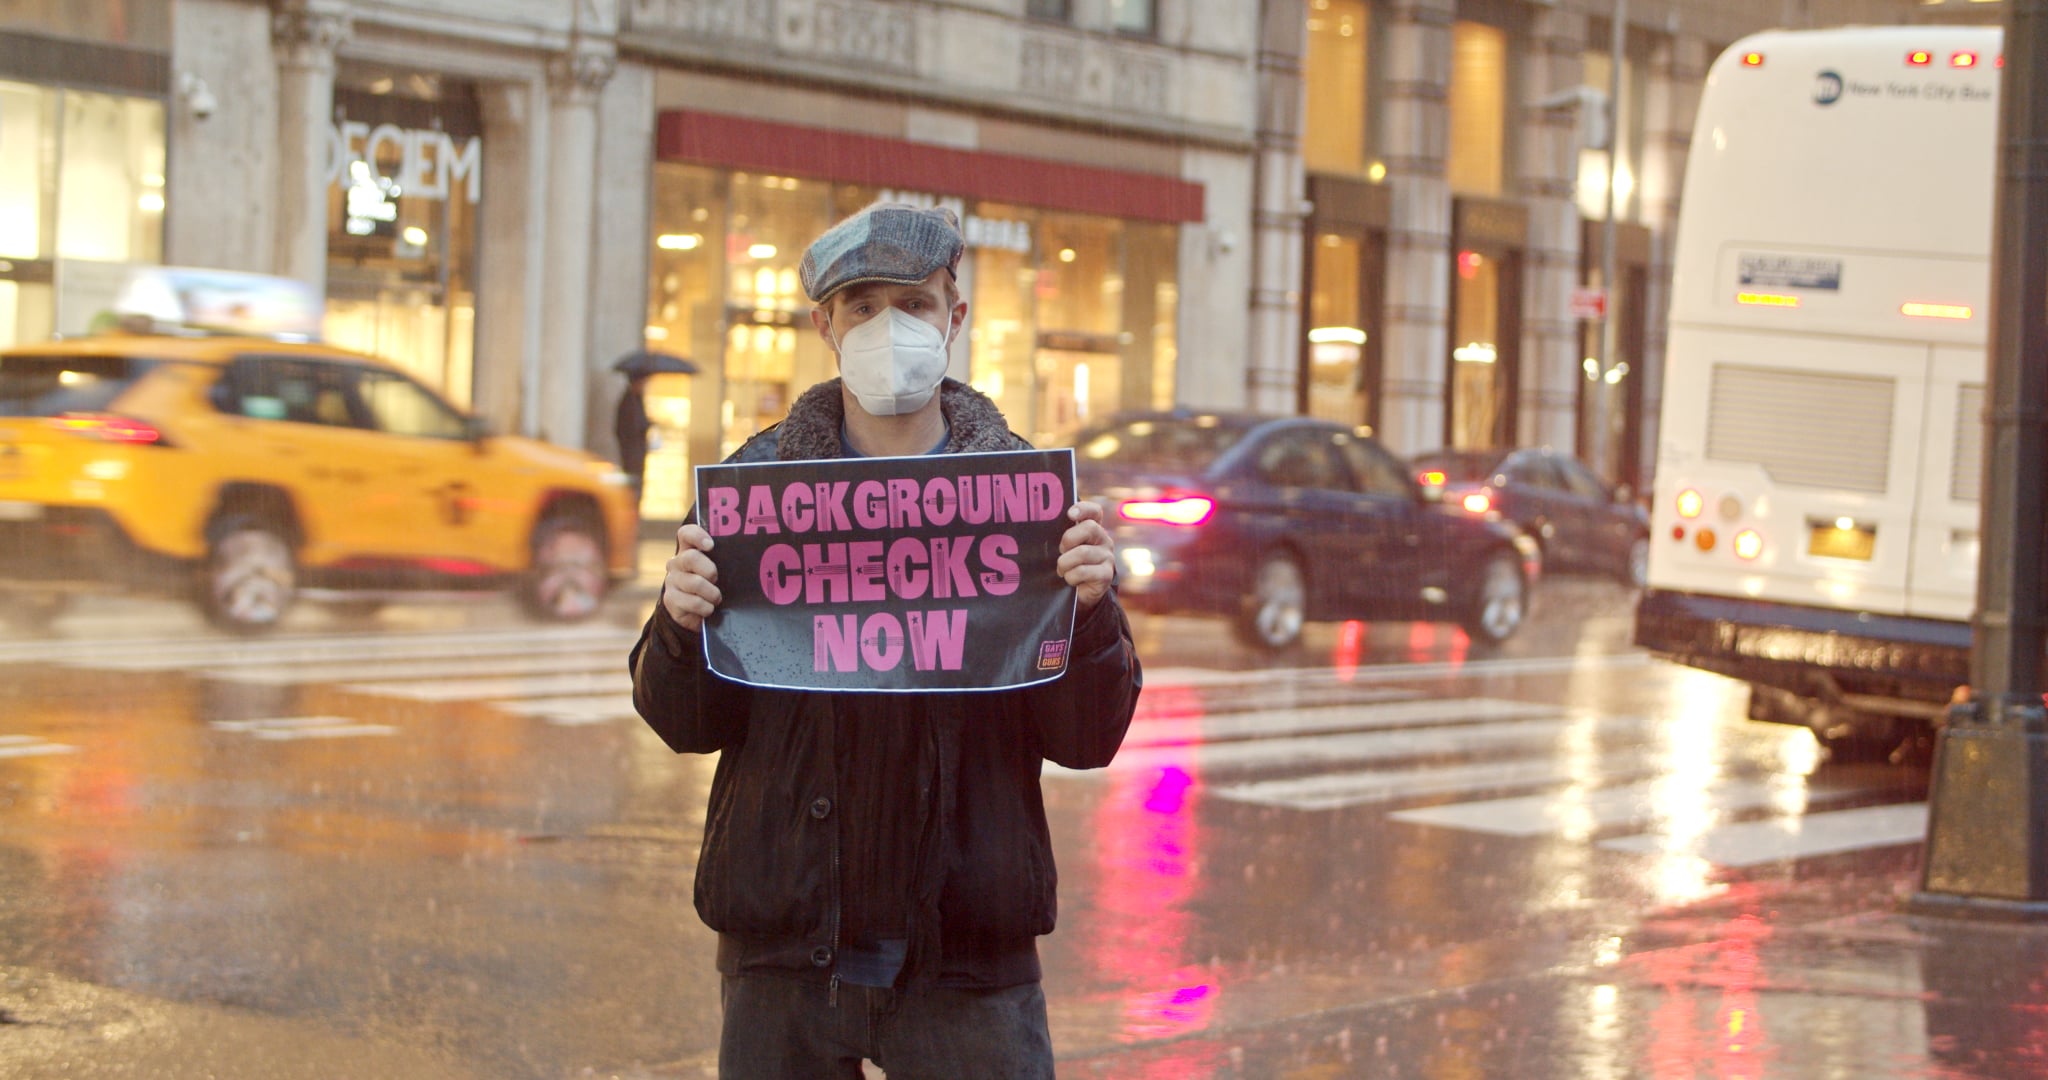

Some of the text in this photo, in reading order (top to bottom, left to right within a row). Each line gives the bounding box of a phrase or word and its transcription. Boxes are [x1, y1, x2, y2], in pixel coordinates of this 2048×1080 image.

[708, 471, 1065, 537] BACKGROUND
[759, 534, 1021, 605] CHECKS
[814, 609, 968, 673] NOW
[1042, 658, 1060, 667] GUNS
[1045, 643, 1064, 652] GAYS
